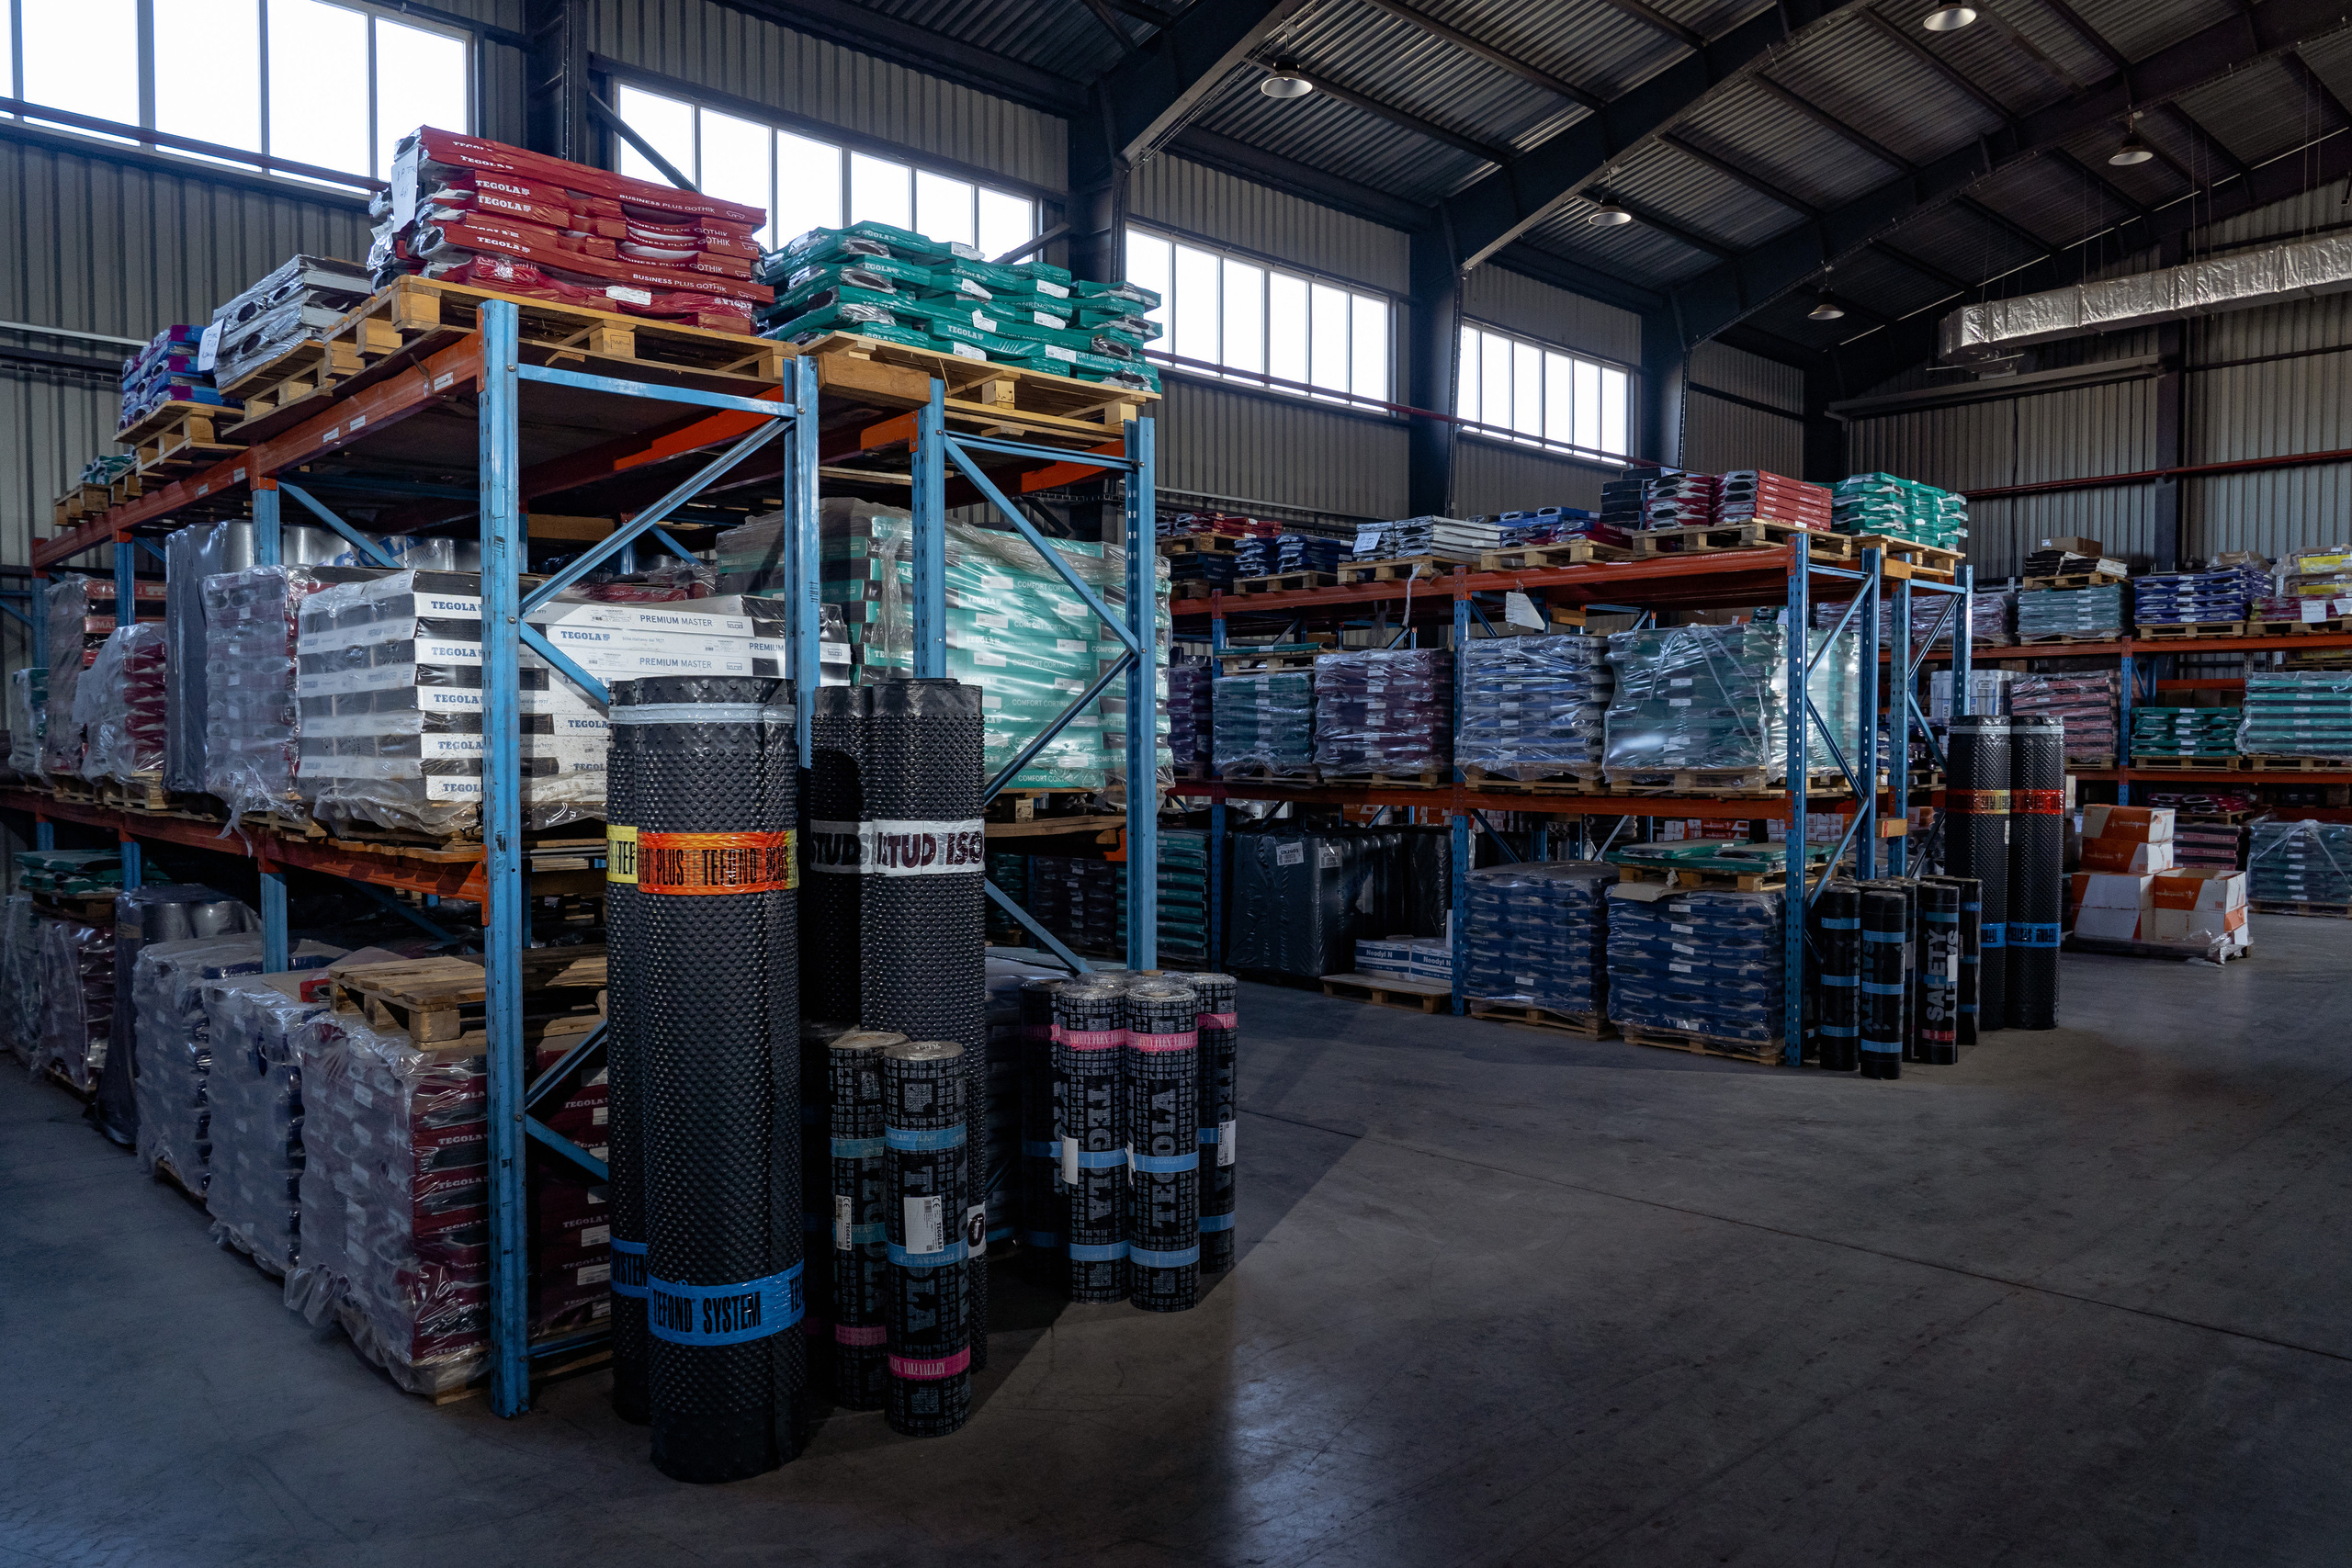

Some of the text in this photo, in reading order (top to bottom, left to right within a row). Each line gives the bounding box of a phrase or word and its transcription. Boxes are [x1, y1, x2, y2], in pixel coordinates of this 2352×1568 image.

[475, 180, 521, 195] TEGOLA
[478, 196, 523, 211] TEGOLA
[619, 194, 660, 207] BUSINESS
[684, 205, 715, 214] GOTHIK
[477, 236, 520, 251] TEGOLA
[697, 235, 730, 247] GOTHIK
[689, 263, 723, 275] GOTHIK
[632, 274, 673, 285] BUSINESS
[695, 283, 727, 293] GOTHIK
[947, 324, 978, 340] TEGOLA
[1091, 355, 1118, 366] SANREMO
[1017, 581, 1047, 591] COMFORT
[431, 601, 476, 612] TEGOLA
[640, 615, 713, 627] PREMIUM MASTER
[1046, 623, 1071, 632] CORTINA
[560, 631, 602, 641] TEGOLA
[432, 647, 476, 658] TEGOLA
[749, 643, 784, 651] PREMIUM
[1091, 645, 1119, 653] COMFORT
[639, 657, 712, 669] PREMIUM MASTER
[1012, 659, 1070, 670] COMFORT CORTINA
[434, 694, 479, 705] TEGOLA
[1012, 698, 1042, 707] COMFORT
[568, 719, 608, 728] TEGOLA
[438, 740, 483, 750] TEGOLA
[1094, 755, 1122, 763] COMFORT
[572, 762, 606, 772] TEGOL
[443, 783, 481, 793] TEGOL
[656, 849, 684, 886] PLUS
[701, 849, 758, 886] TEFOND
[1366, 949, 1386, 959] Neodyl
[1423, 956, 1444, 966] Neodyl
[564, 1099, 604, 1109] TEGOLA
[438, 1134, 481, 1145] TEGOLA
[438, 1177, 481, 1190] TEGOLA
[562, 1216, 602, 1228] TEGOLA
[653, 1289, 693, 1333] TEFOND
[703, 1291, 762, 1335] SYSTEM
